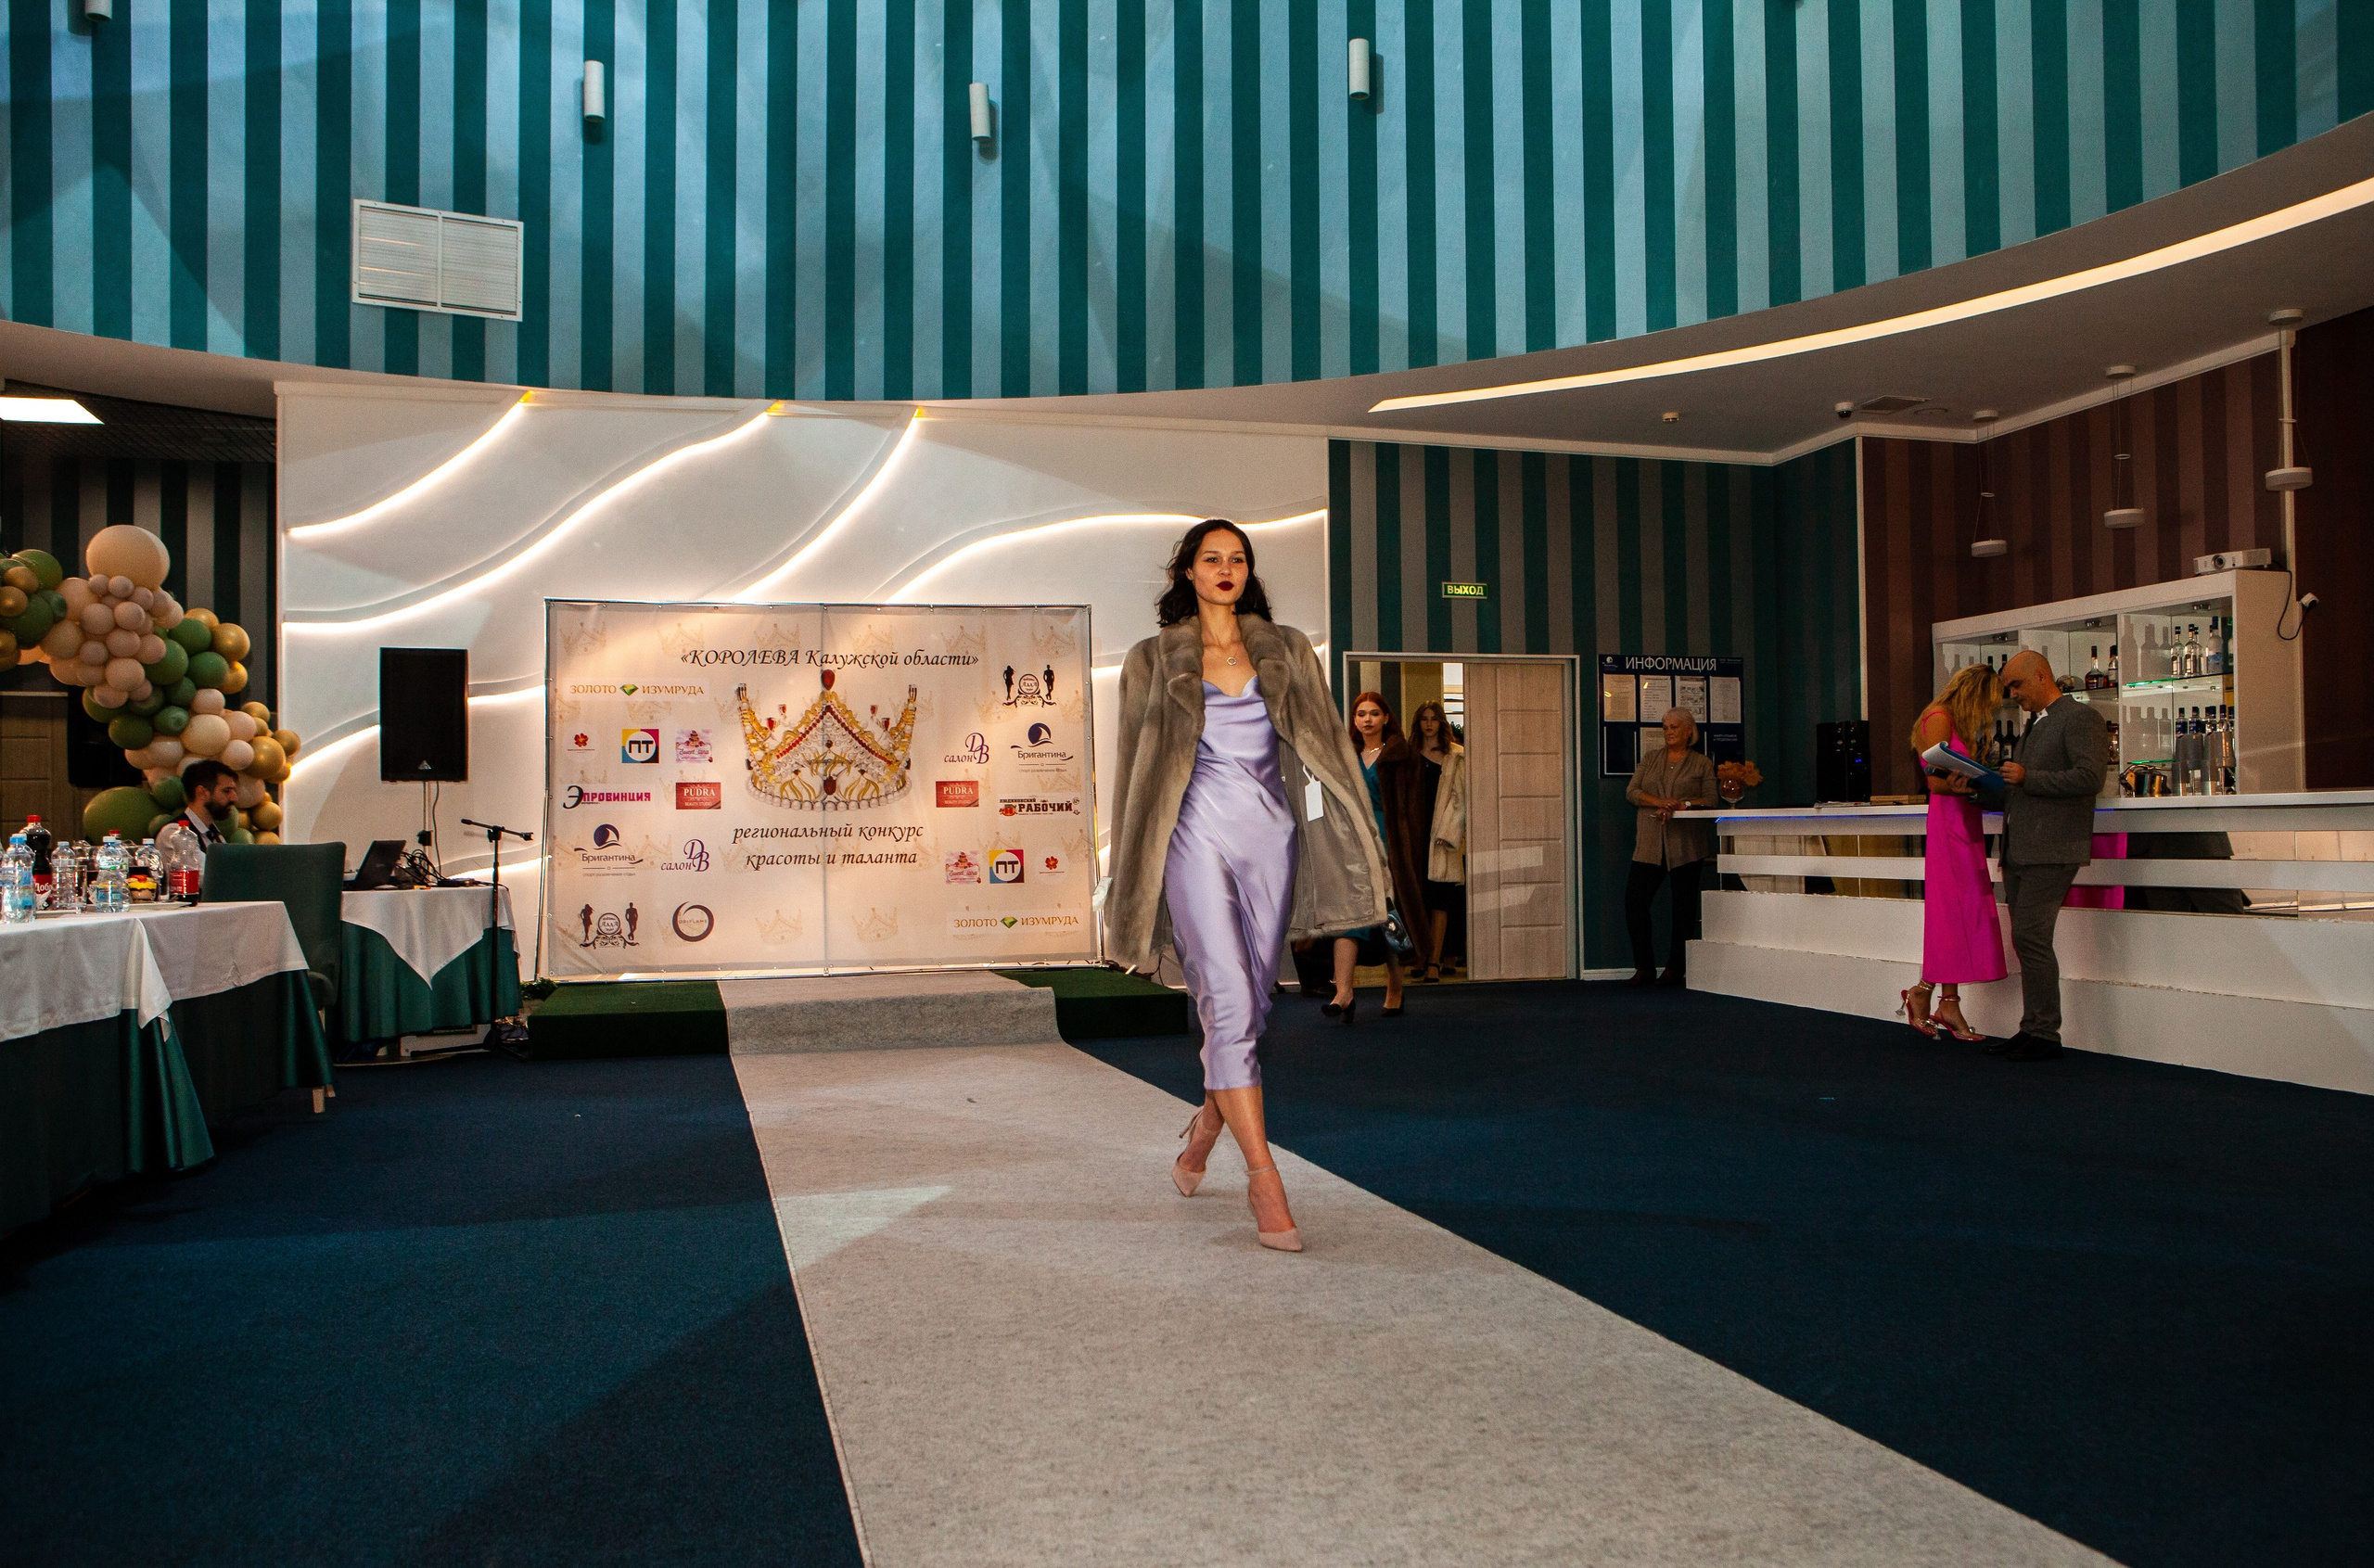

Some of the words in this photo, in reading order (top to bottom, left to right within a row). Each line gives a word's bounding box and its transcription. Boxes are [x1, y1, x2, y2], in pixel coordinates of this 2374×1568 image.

[1447, 585, 1484, 595] ВЫХОД
[681, 649, 800, 667] «КОРОЛЕВА
[805, 650, 900, 669] Калужской
[903, 649, 979, 667] области»
[1625, 657, 1717, 672] ИНФОРМАЦИЯ
[569, 684, 618, 695] ЗОЛОТО
[642, 685, 705, 695] ИЗУМРУДА
[628, 740, 654, 754] ПТ
[944, 755, 973, 763] салон
[1017, 750, 1066, 760] Бригантина
[683, 787, 716, 797] PUDRA
[943, 786, 974, 795] PUDRA
[1017, 800, 1073, 812] РАБОЧИЙ
[732, 823, 853, 844] региональный
[858, 825, 924, 842] конкурс
[581, 853, 636, 864] Бригантина
[746, 854, 821, 871] красоты
[826, 854, 836, 865] и
[842, 853, 918, 864] таланта
[660, 862, 692, 871] салон
[995, 860, 1019, 873] ПТ
[953, 918, 998, 928] ЗОЛОТО
[1021, 915, 1079, 926] ИЗУМРУДА
